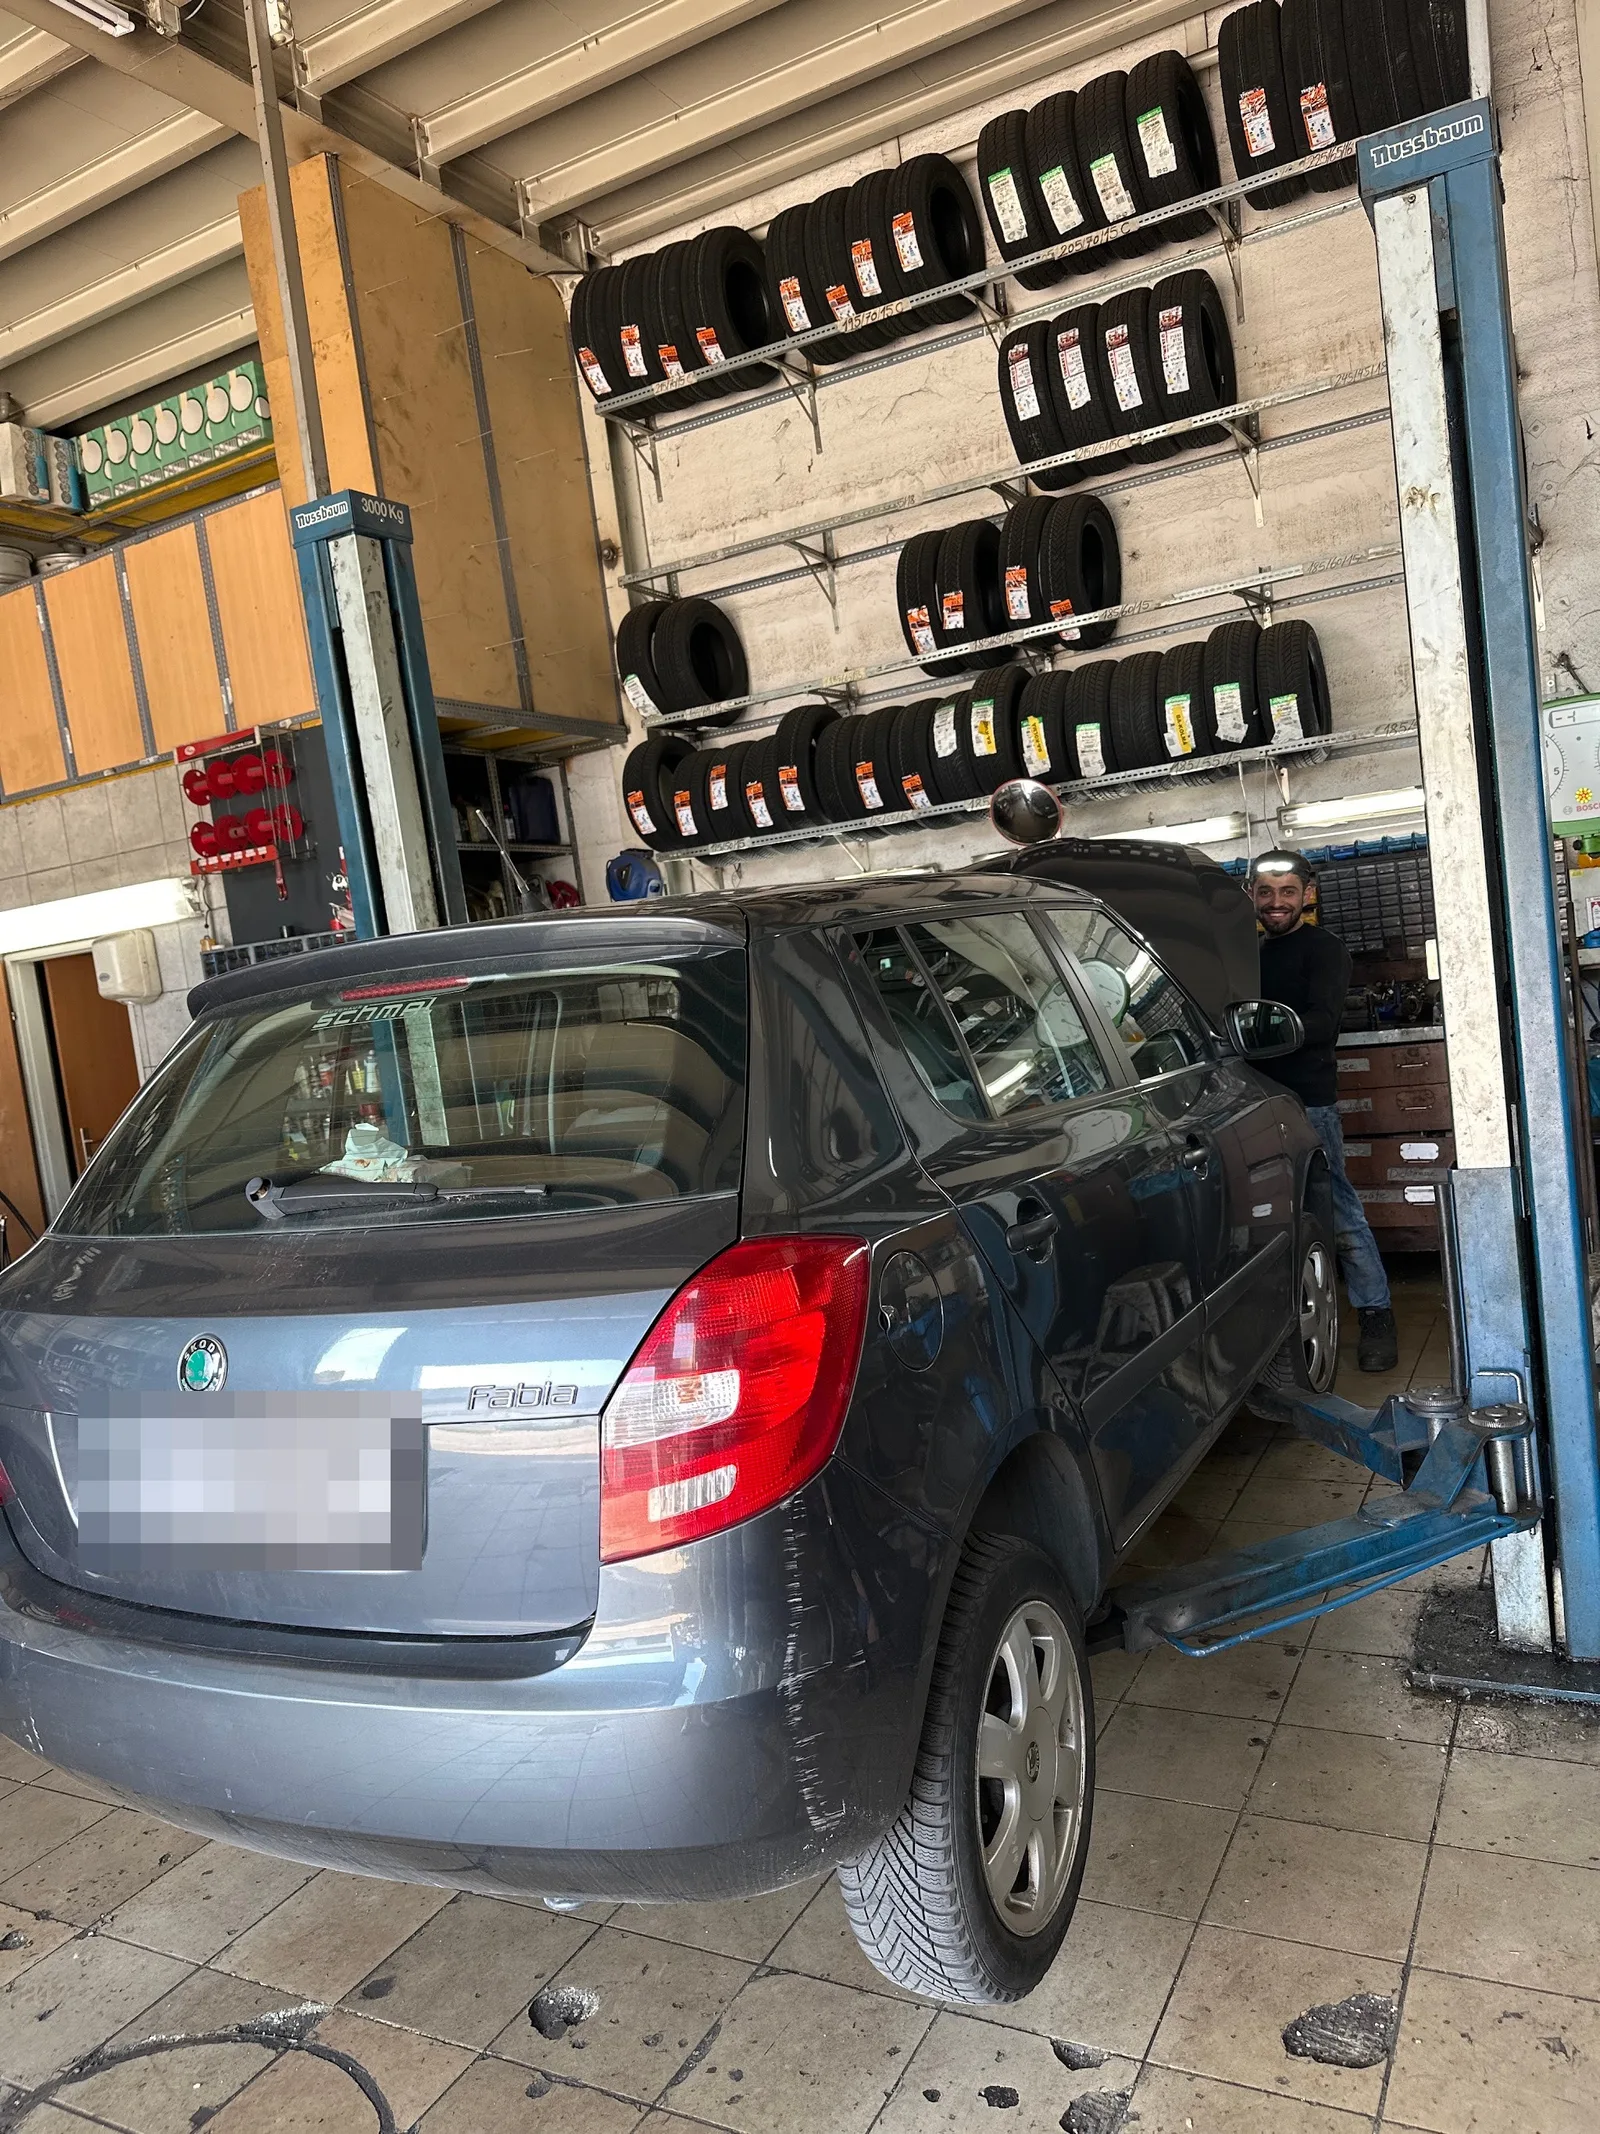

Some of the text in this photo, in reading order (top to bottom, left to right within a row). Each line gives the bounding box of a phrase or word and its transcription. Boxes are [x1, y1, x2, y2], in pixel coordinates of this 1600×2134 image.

[361, 497, 404, 524] 3000 Kg
[468, 1381, 579, 1410] Fabia
